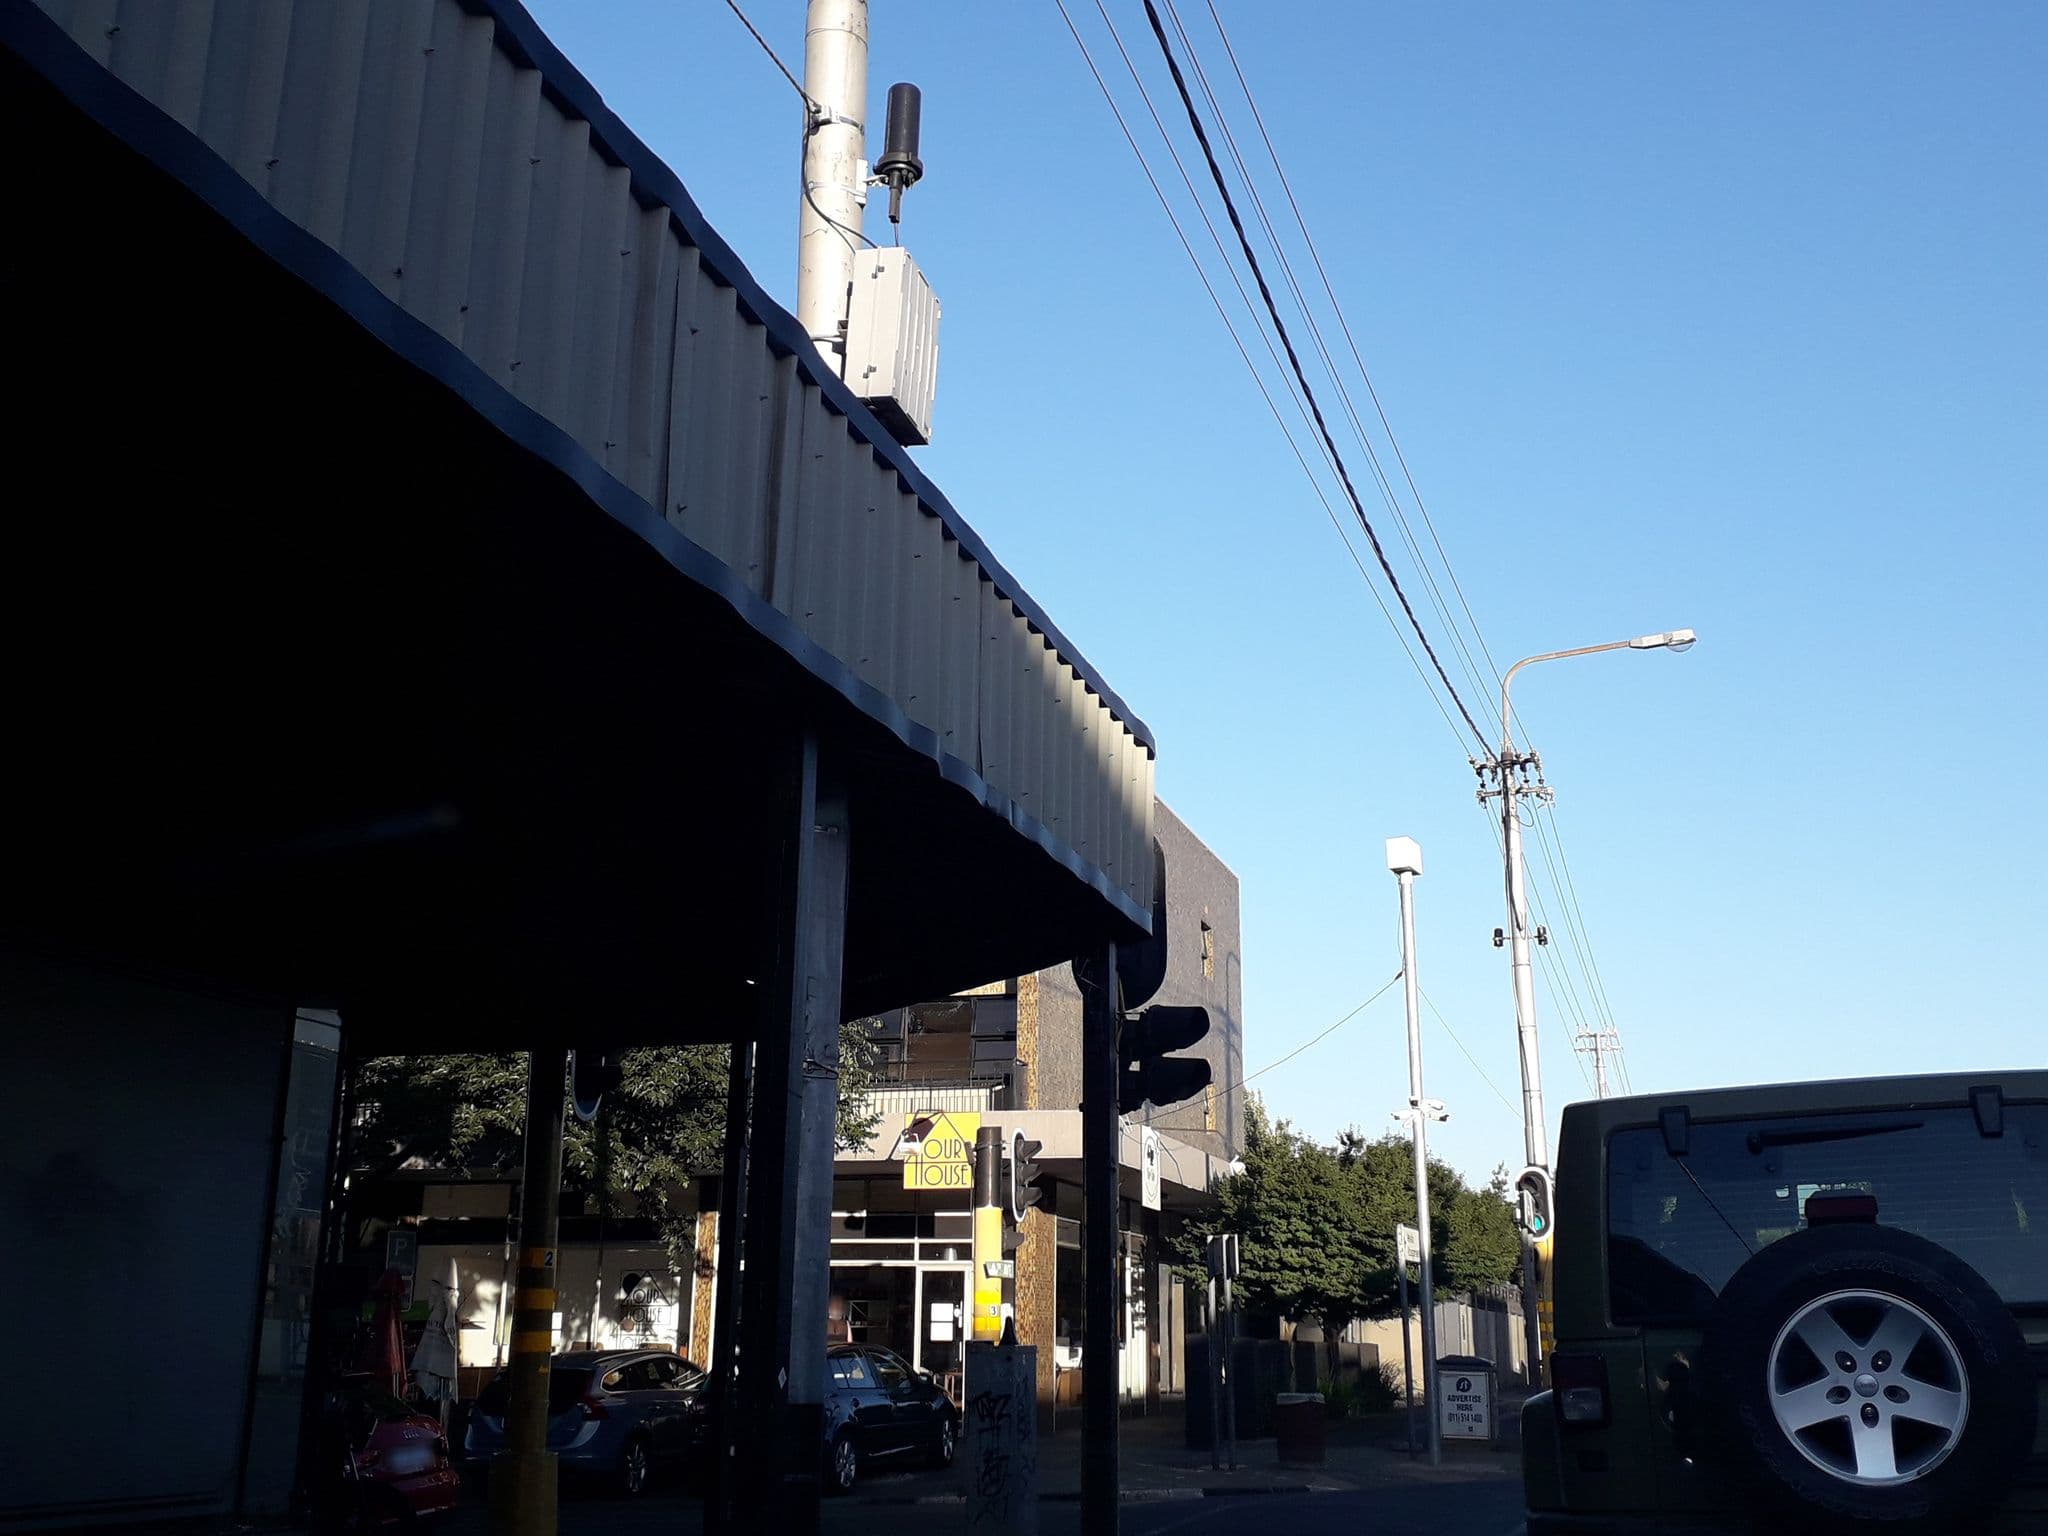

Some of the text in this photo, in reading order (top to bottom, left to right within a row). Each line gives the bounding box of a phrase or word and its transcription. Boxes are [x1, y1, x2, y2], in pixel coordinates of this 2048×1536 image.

[924, 1139, 962, 1160] OUR
[910, 1156, 969, 1186] HOUSE
[544, 1251, 553, 1266] 2
[633, 1288, 660, 1304] OUR
[1447, 1394, 1482, 1403] ADVERTISE
